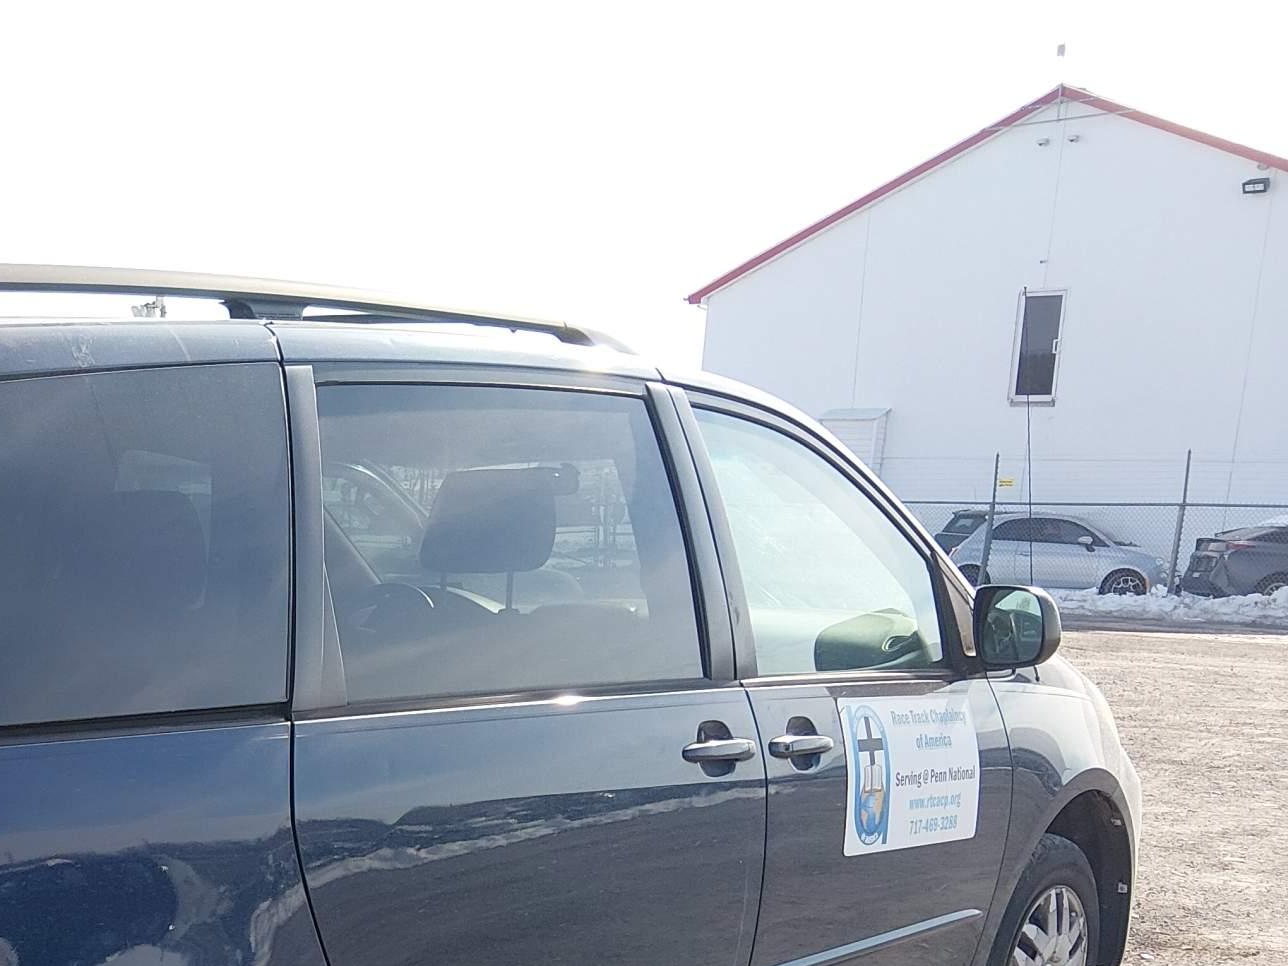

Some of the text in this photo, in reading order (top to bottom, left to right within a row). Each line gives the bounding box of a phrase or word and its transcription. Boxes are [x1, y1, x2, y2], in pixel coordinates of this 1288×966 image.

[890, 710, 911, 724] Race
[909, 709, 930, 723] Track
[915, 731, 953, 749] of America
[895, 764, 976, 788] Serving @ Penn National
